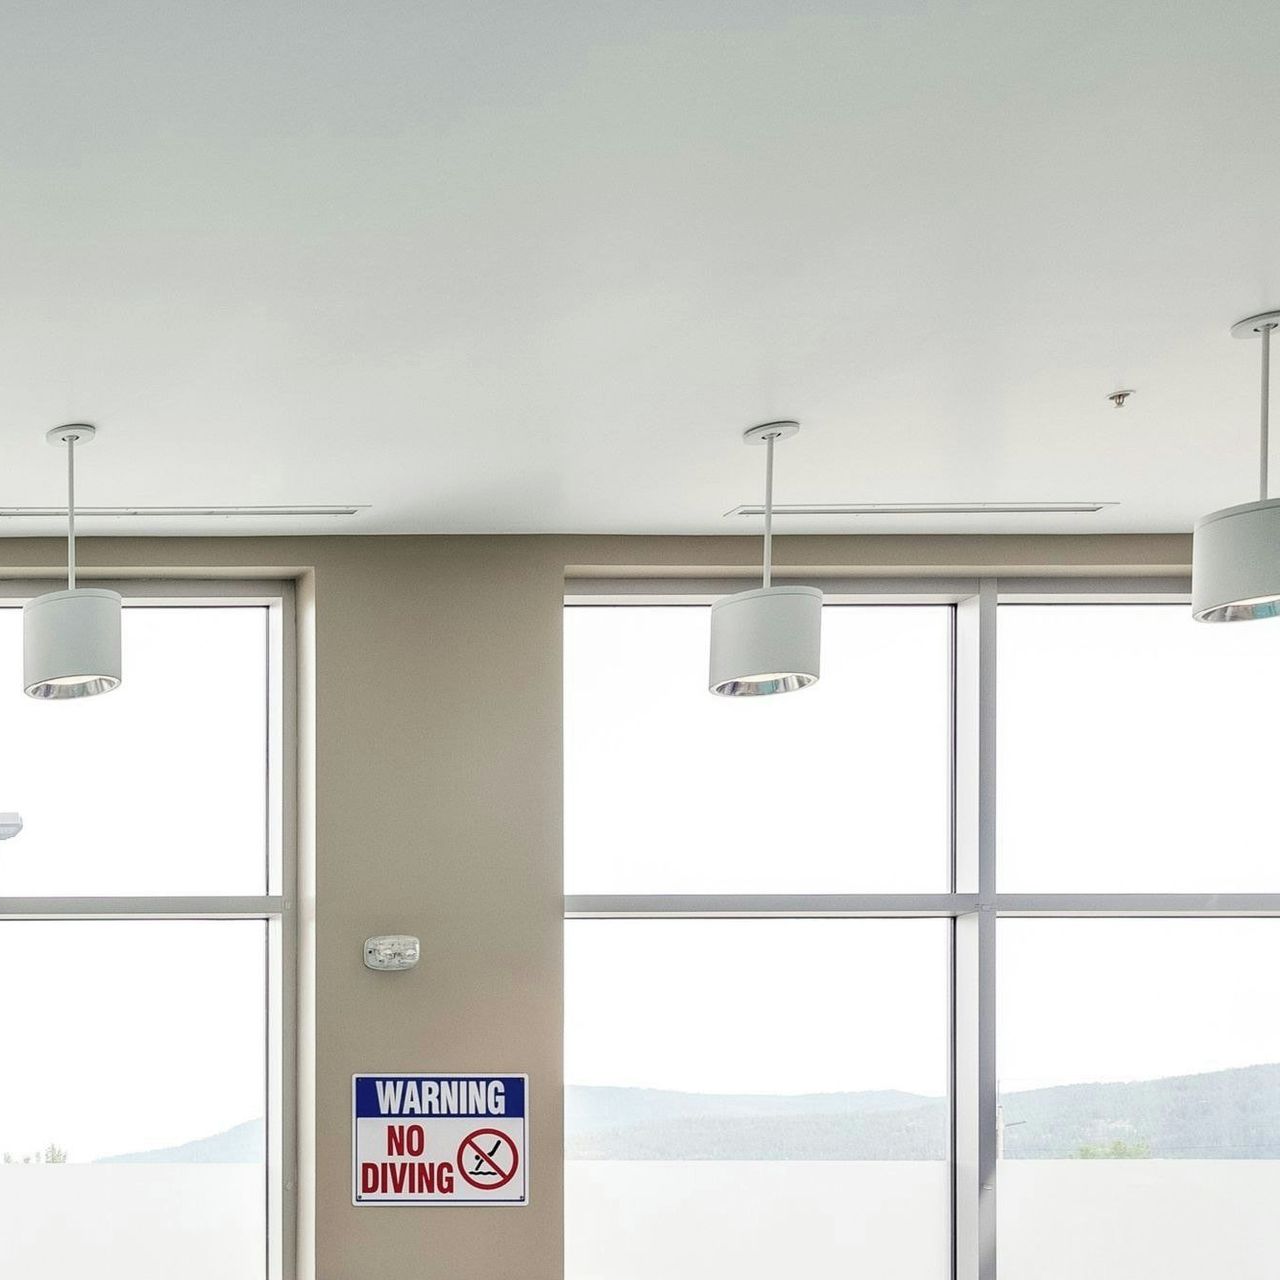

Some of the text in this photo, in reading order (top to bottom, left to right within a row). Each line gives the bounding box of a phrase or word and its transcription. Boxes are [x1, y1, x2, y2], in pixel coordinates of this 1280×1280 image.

[375, 1080, 506, 1115] WARNING
[387, 1124, 425, 1157] NO
[361, 1162, 454, 1194] DIVING
